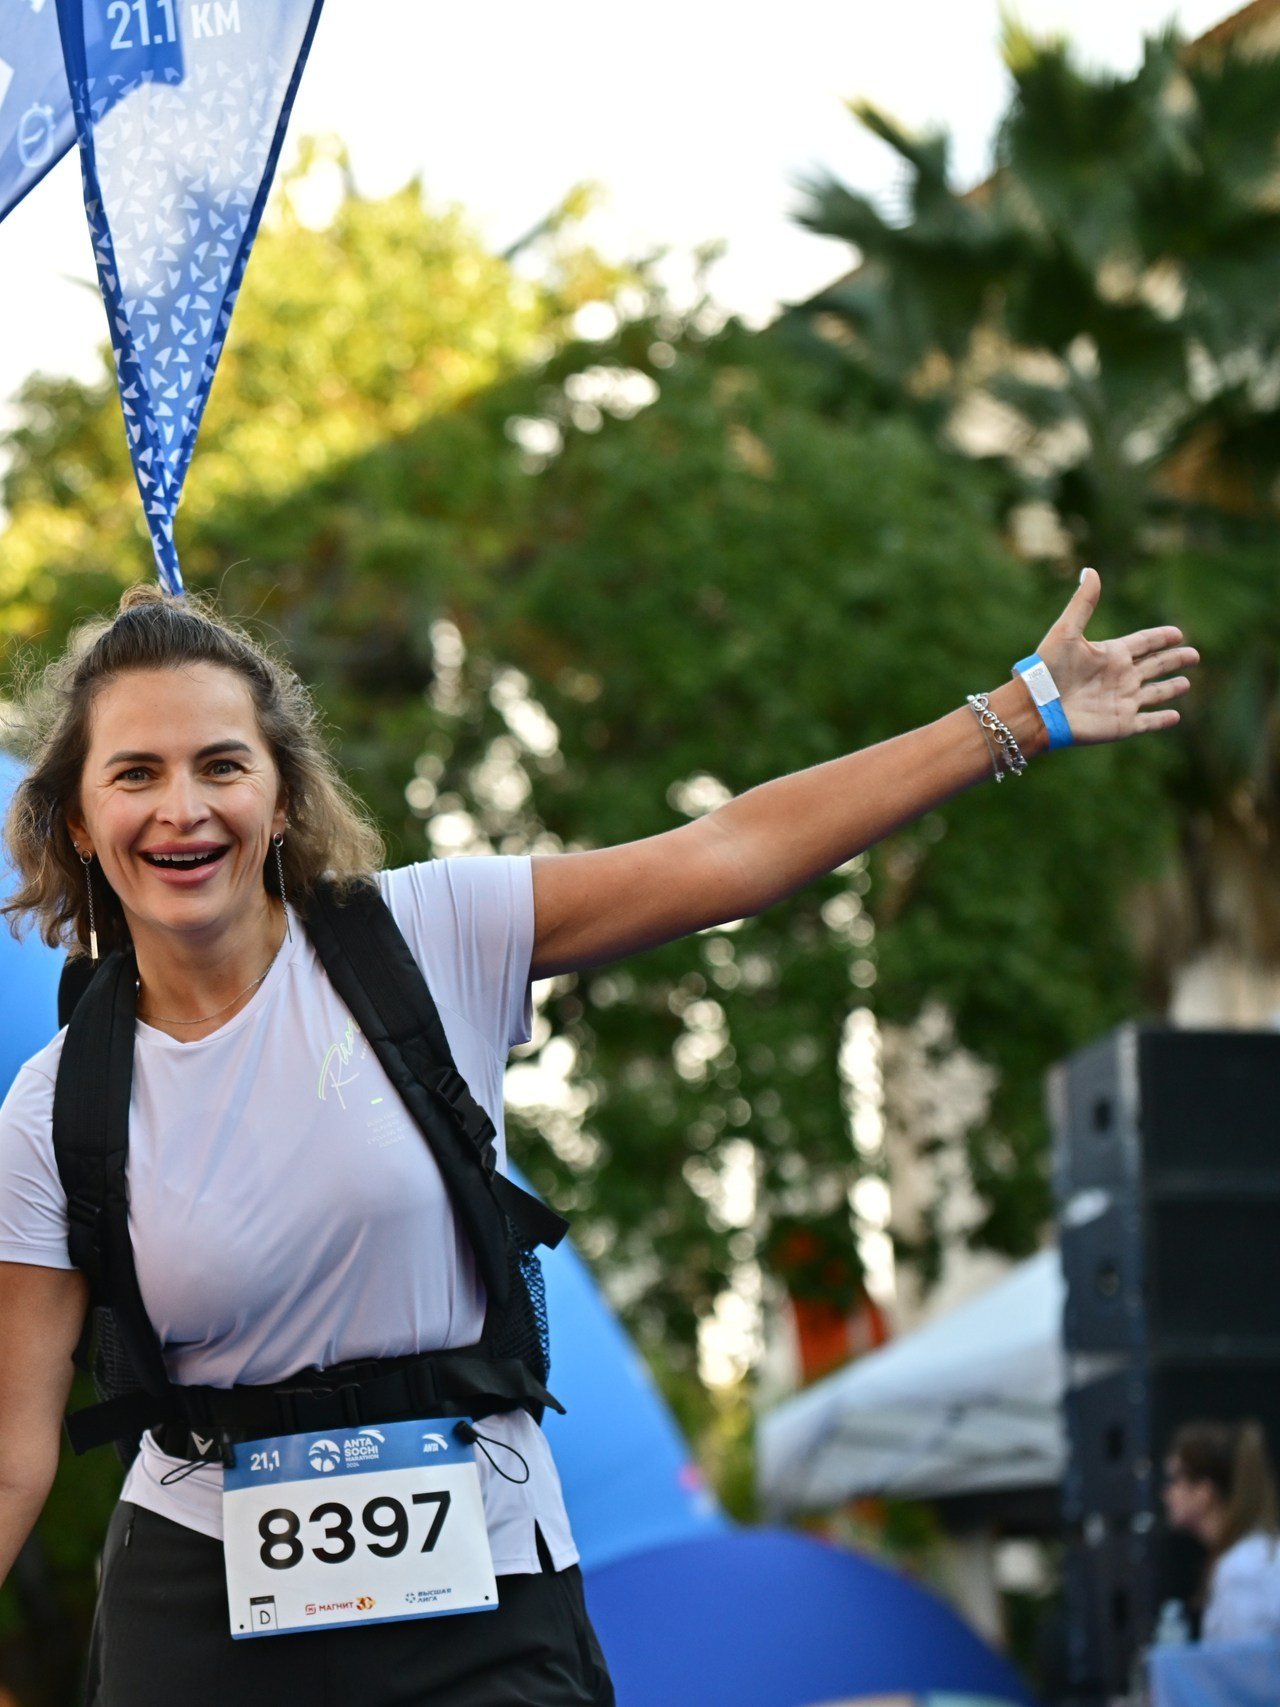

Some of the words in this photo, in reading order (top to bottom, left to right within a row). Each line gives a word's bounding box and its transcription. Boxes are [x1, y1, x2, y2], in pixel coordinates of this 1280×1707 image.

[107, 0, 176, 50] 21.1
[343, 1437, 373, 1449] ANTA
[423, 1443, 439, 1453] ANTA
[344, 1445, 379, 1457] SOCHI
[250, 1450, 280, 1472] 21,1
[345, 1454, 379, 1463] MARATHON
[258, 1490, 451, 1570] 8397
[319, 1602, 353, 1611] МАГНИТ
